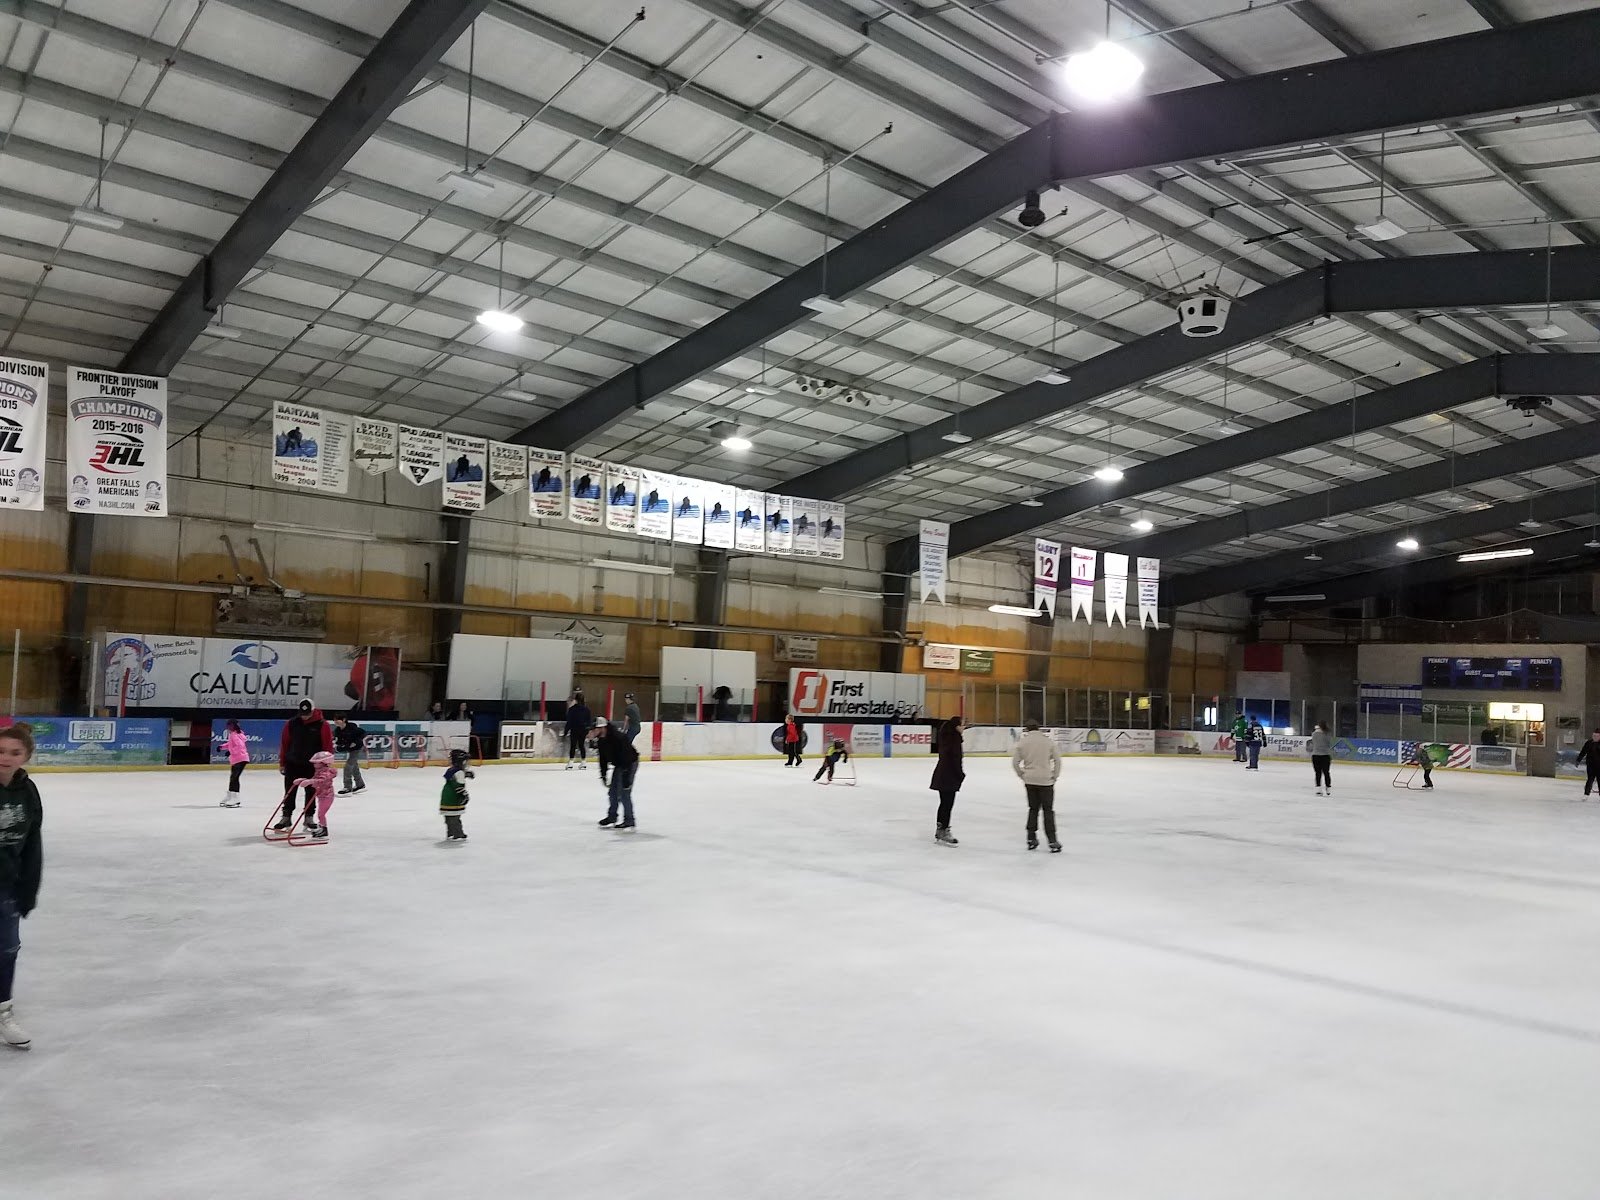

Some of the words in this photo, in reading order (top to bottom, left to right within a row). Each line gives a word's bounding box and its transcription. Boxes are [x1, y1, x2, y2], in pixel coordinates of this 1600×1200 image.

[77, 371, 119, 386] FRONTIER
[121, 376, 159, 390] DIVISION
[100, 385, 137, 398] PLAYOFF
[77, 402, 157, 421] CHAMPIONS
[278, 405, 319, 420] BANTAM
[92, 419, 144, 434] 2015-2016
[361, 422, 389, 433] SPUD
[356, 427, 393, 440] LEAGUE
[88, 444, 145, 467] 3HL
[96, 477, 118, 486] GREAT
[119, 479, 140, 488] FALLS
[274, 473, 289, 482] 1999
[98, 486, 139, 497] AMERICANS
[99, 500, 135, 510] NA3HL.COM
[1039, 556, 1054, 578] 12
[154, 641, 174, 649] Home
[175, 640, 196, 648] Bench
[152, 650, 188, 660] Sponsored
[190, 672, 313, 696] CALUMET
[831, 681, 864, 697] First
[199, 697, 243, 706] MONTANA
[1253, 729, 1263, 741] 33
[1267, 736, 1304, 746] Heritage
[363, 735, 392, 749] GPD
[399, 735, 426, 748] GPD
[1278, 745, 1293, 753] Inn
[1357, 746, 1397, 757] 453-3466
